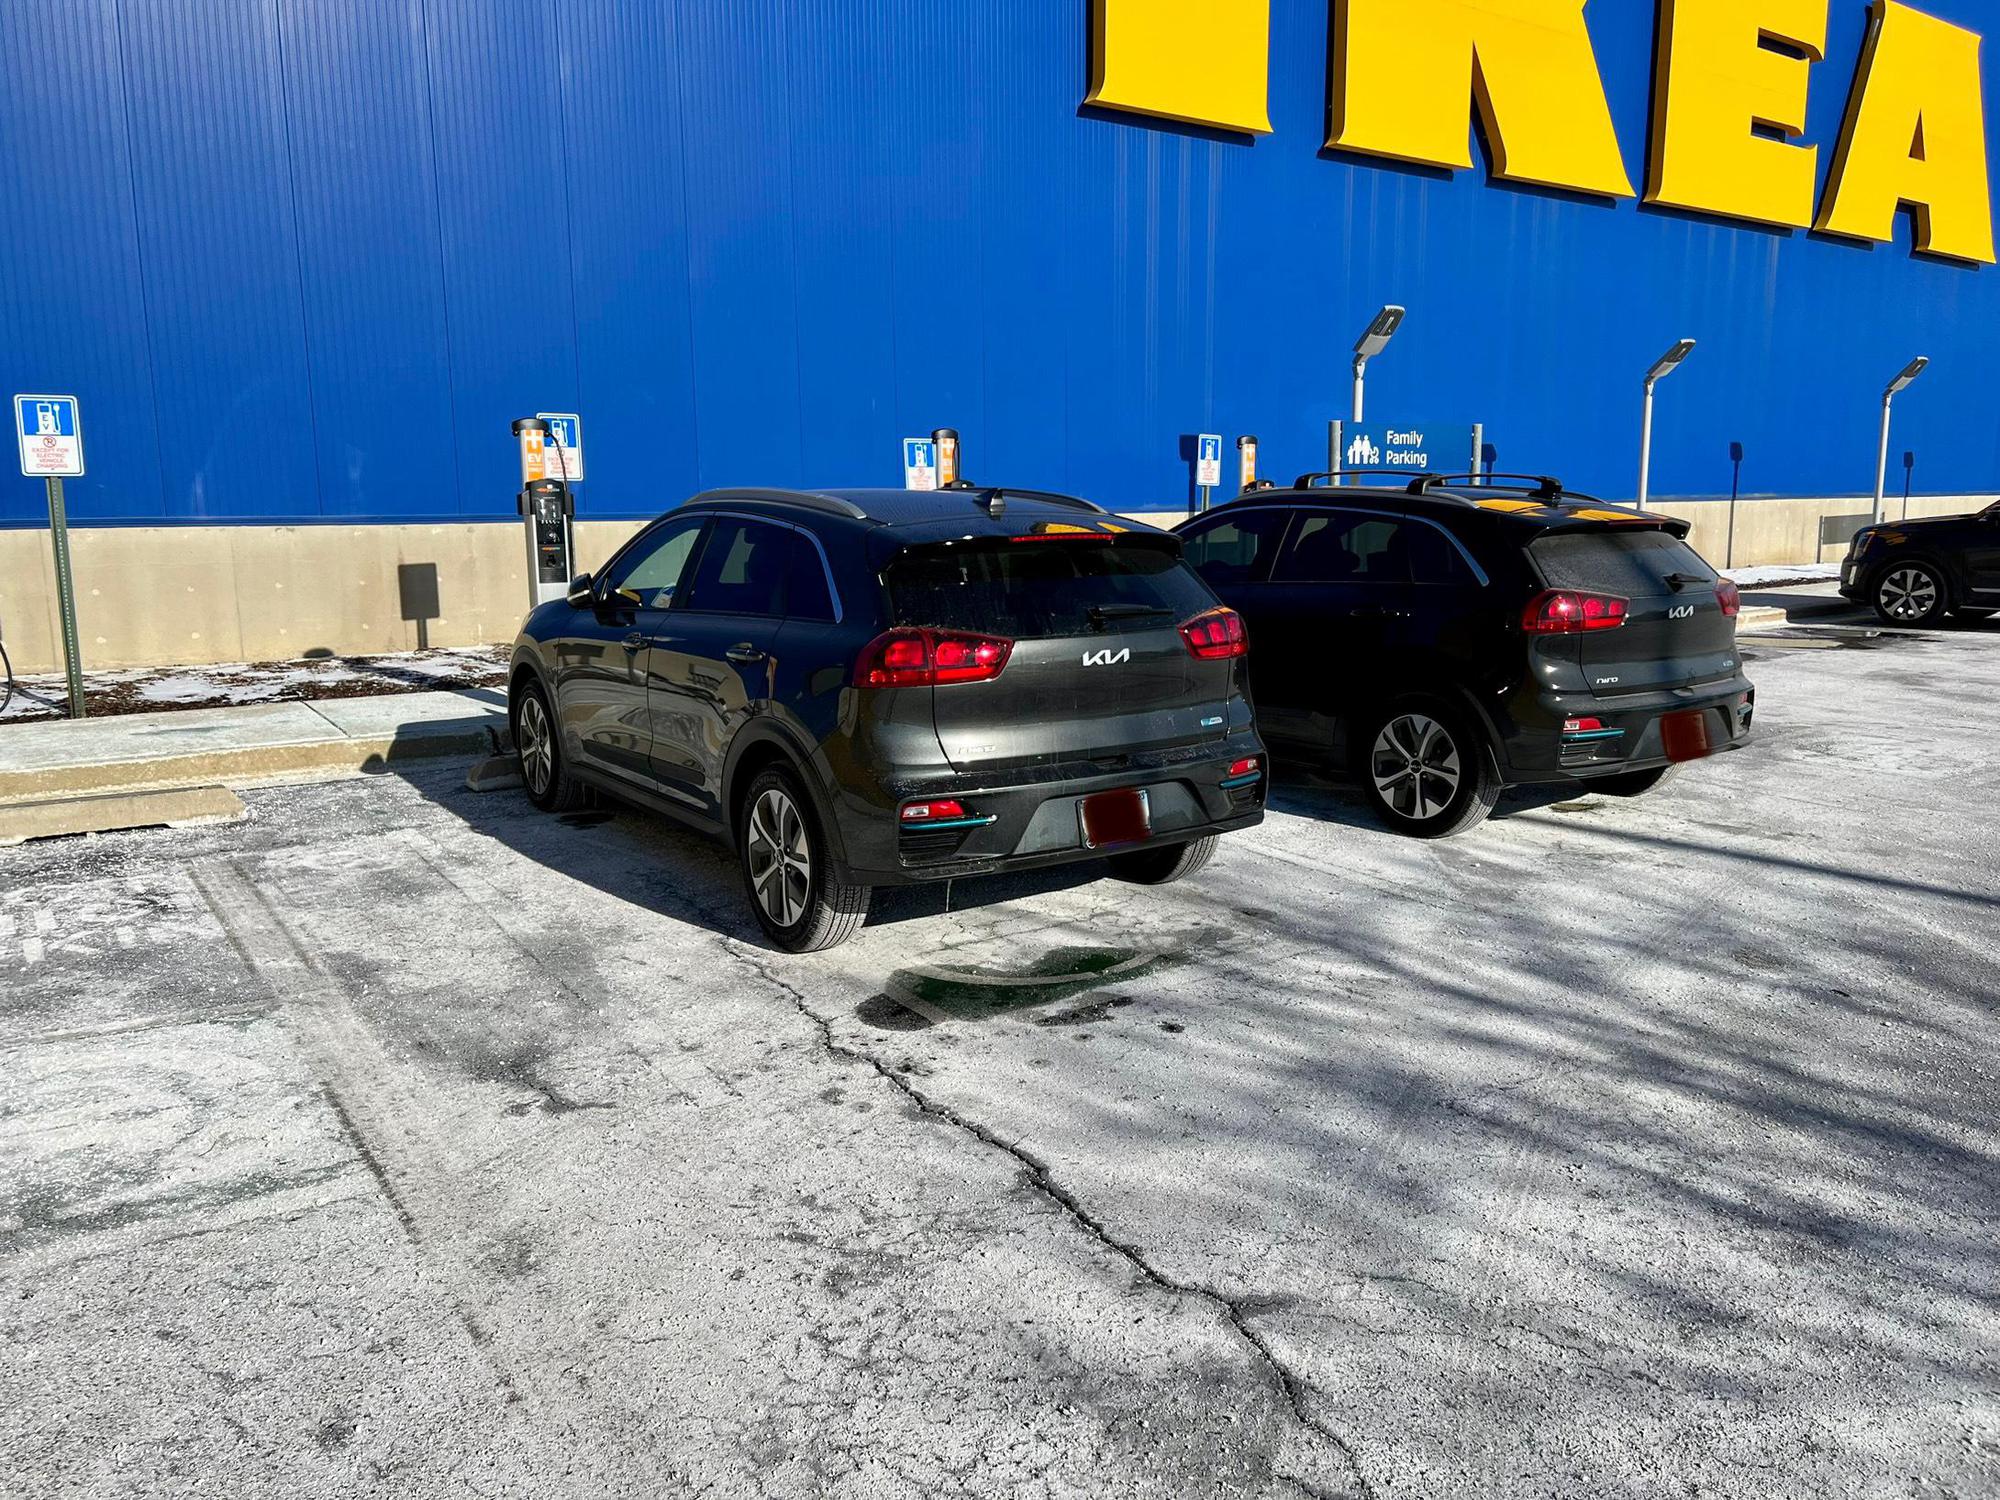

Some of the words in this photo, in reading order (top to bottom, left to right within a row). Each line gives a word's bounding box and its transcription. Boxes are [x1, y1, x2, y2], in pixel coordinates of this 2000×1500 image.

[1386, 430, 1423, 448] Family
[1386, 451, 1427, 468] Parking
[1668, 605, 1694, 619] KIA
[1082, 648, 1129, 667] KIA
